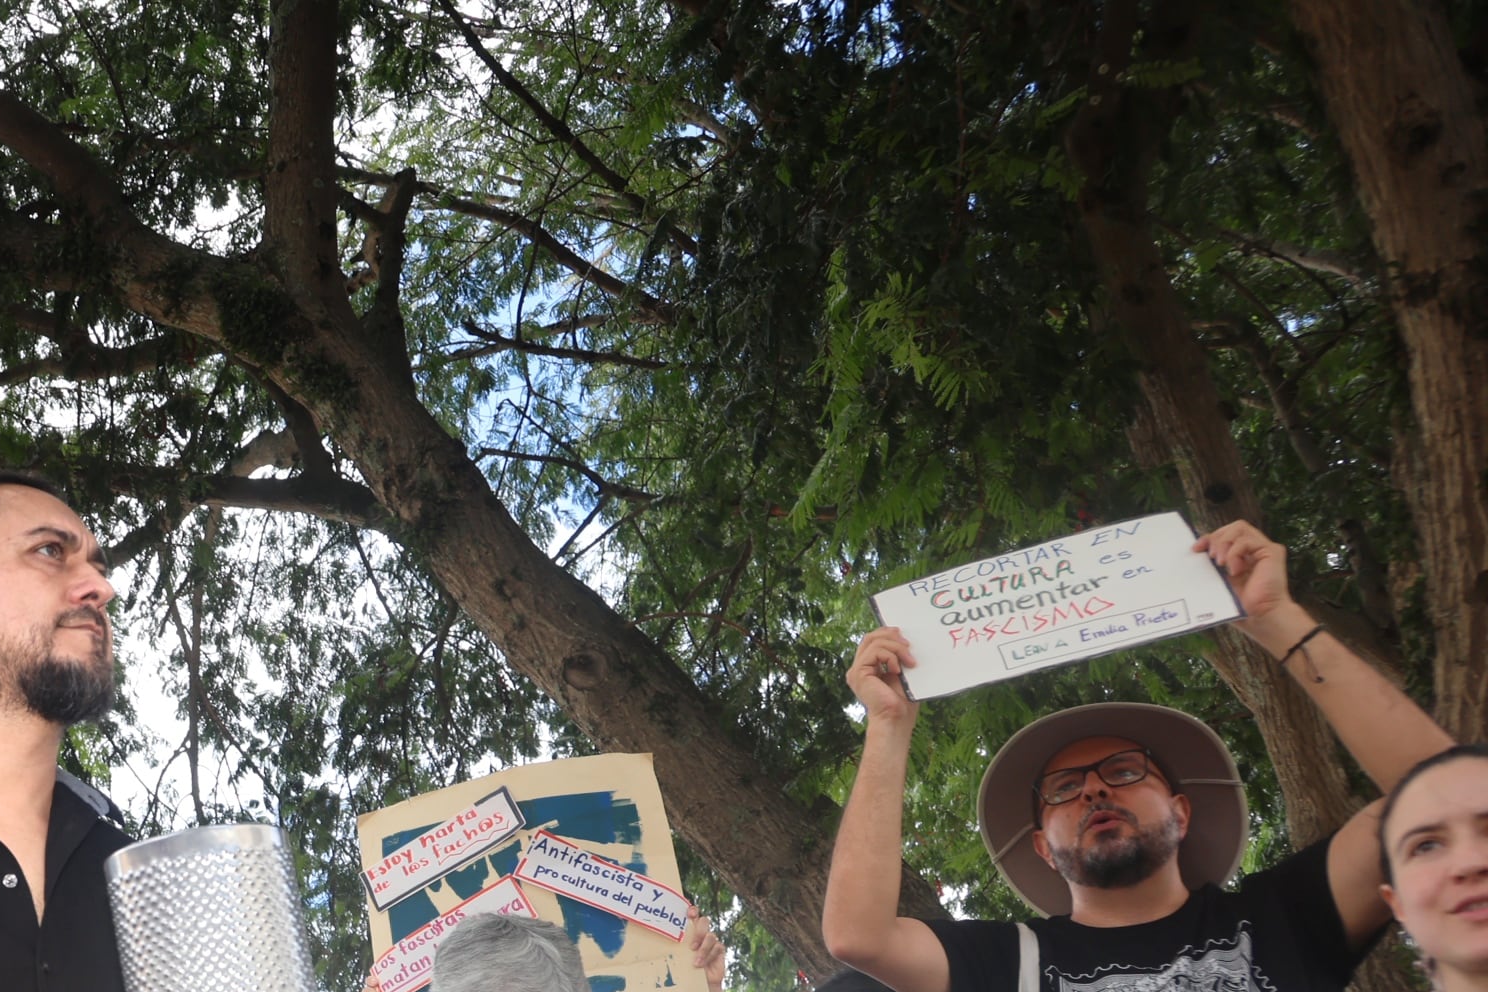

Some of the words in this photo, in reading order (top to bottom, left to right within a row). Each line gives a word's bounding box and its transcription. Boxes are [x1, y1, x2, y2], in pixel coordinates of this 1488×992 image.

[909, 543, 1072, 596] RECORTAR
[1091, 522, 1141, 546] EN
[931, 559, 1075, 609] CULTURA
[1099, 550, 1133, 565] es
[941, 576, 1109, 626] aumentar
[1122, 566, 1153, 579] en
[949, 597, 1115, 648] FASCISMO
[1079, 624, 1129, 643] Emilia
[367, 848, 414, 881] Estoy
[374, 879, 391, 894] de
[402, 857, 430, 876] l@s
[527, 838, 644, 891] ¡Antifascista
[533, 864, 559, 879] pro
[561, 874, 609, 897] cultura
[612, 891, 633, 906] del
[634, 902, 687, 930] pueblo!
[398, 909, 466, 956] fascistas
[381, 954, 432, 992] matan
